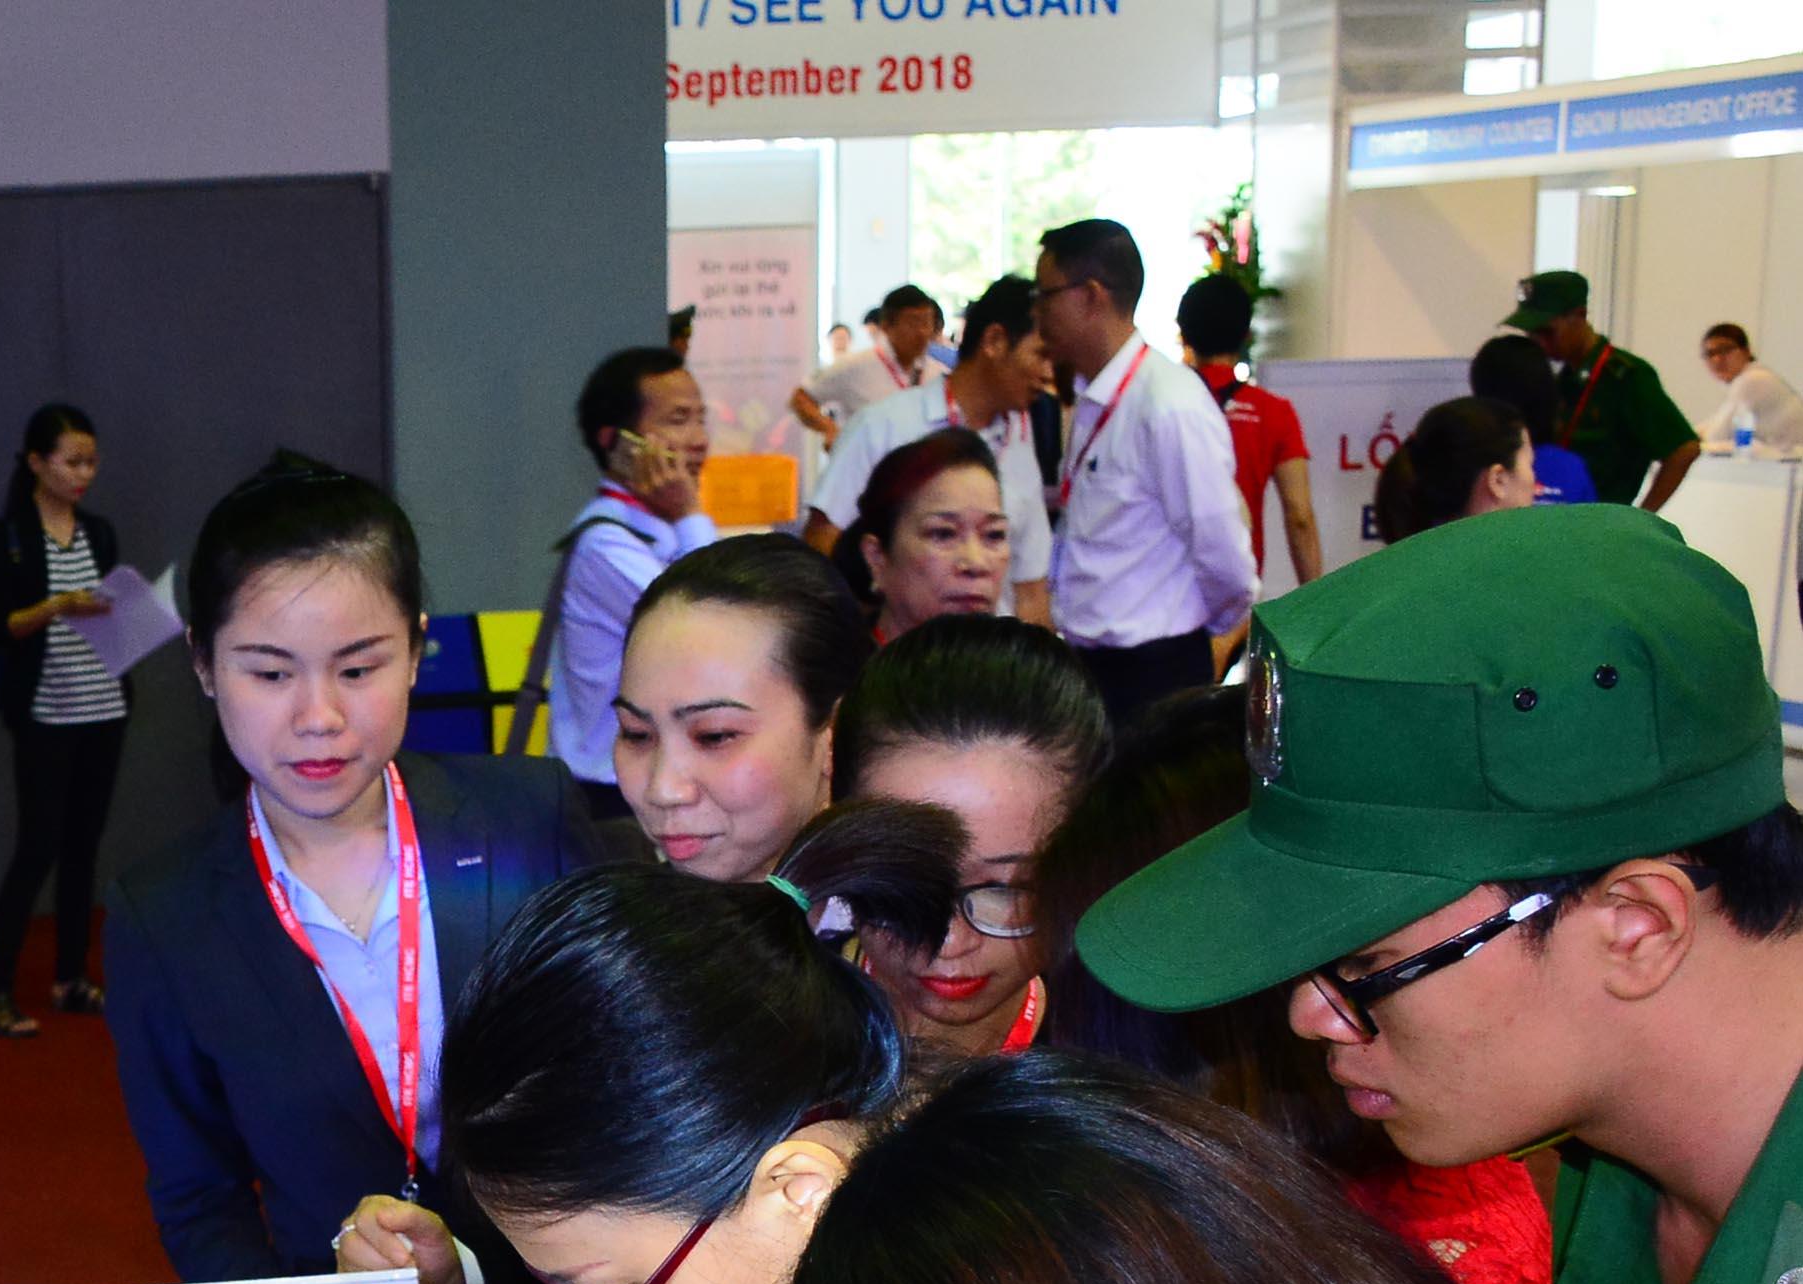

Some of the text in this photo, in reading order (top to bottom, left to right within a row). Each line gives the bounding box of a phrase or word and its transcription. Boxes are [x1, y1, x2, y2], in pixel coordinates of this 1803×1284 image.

[731, 0, 824, 25] SEE
[852, 0, 945, 21] YOU
[665, 54, 973, 106] September 2018
[1489, 117, 1555, 145] COUNTER
[1571, 86, 1797, 138] SHOW MANAGEMENT OFFICE
[1340, 411, 1416, 470] LỐ
